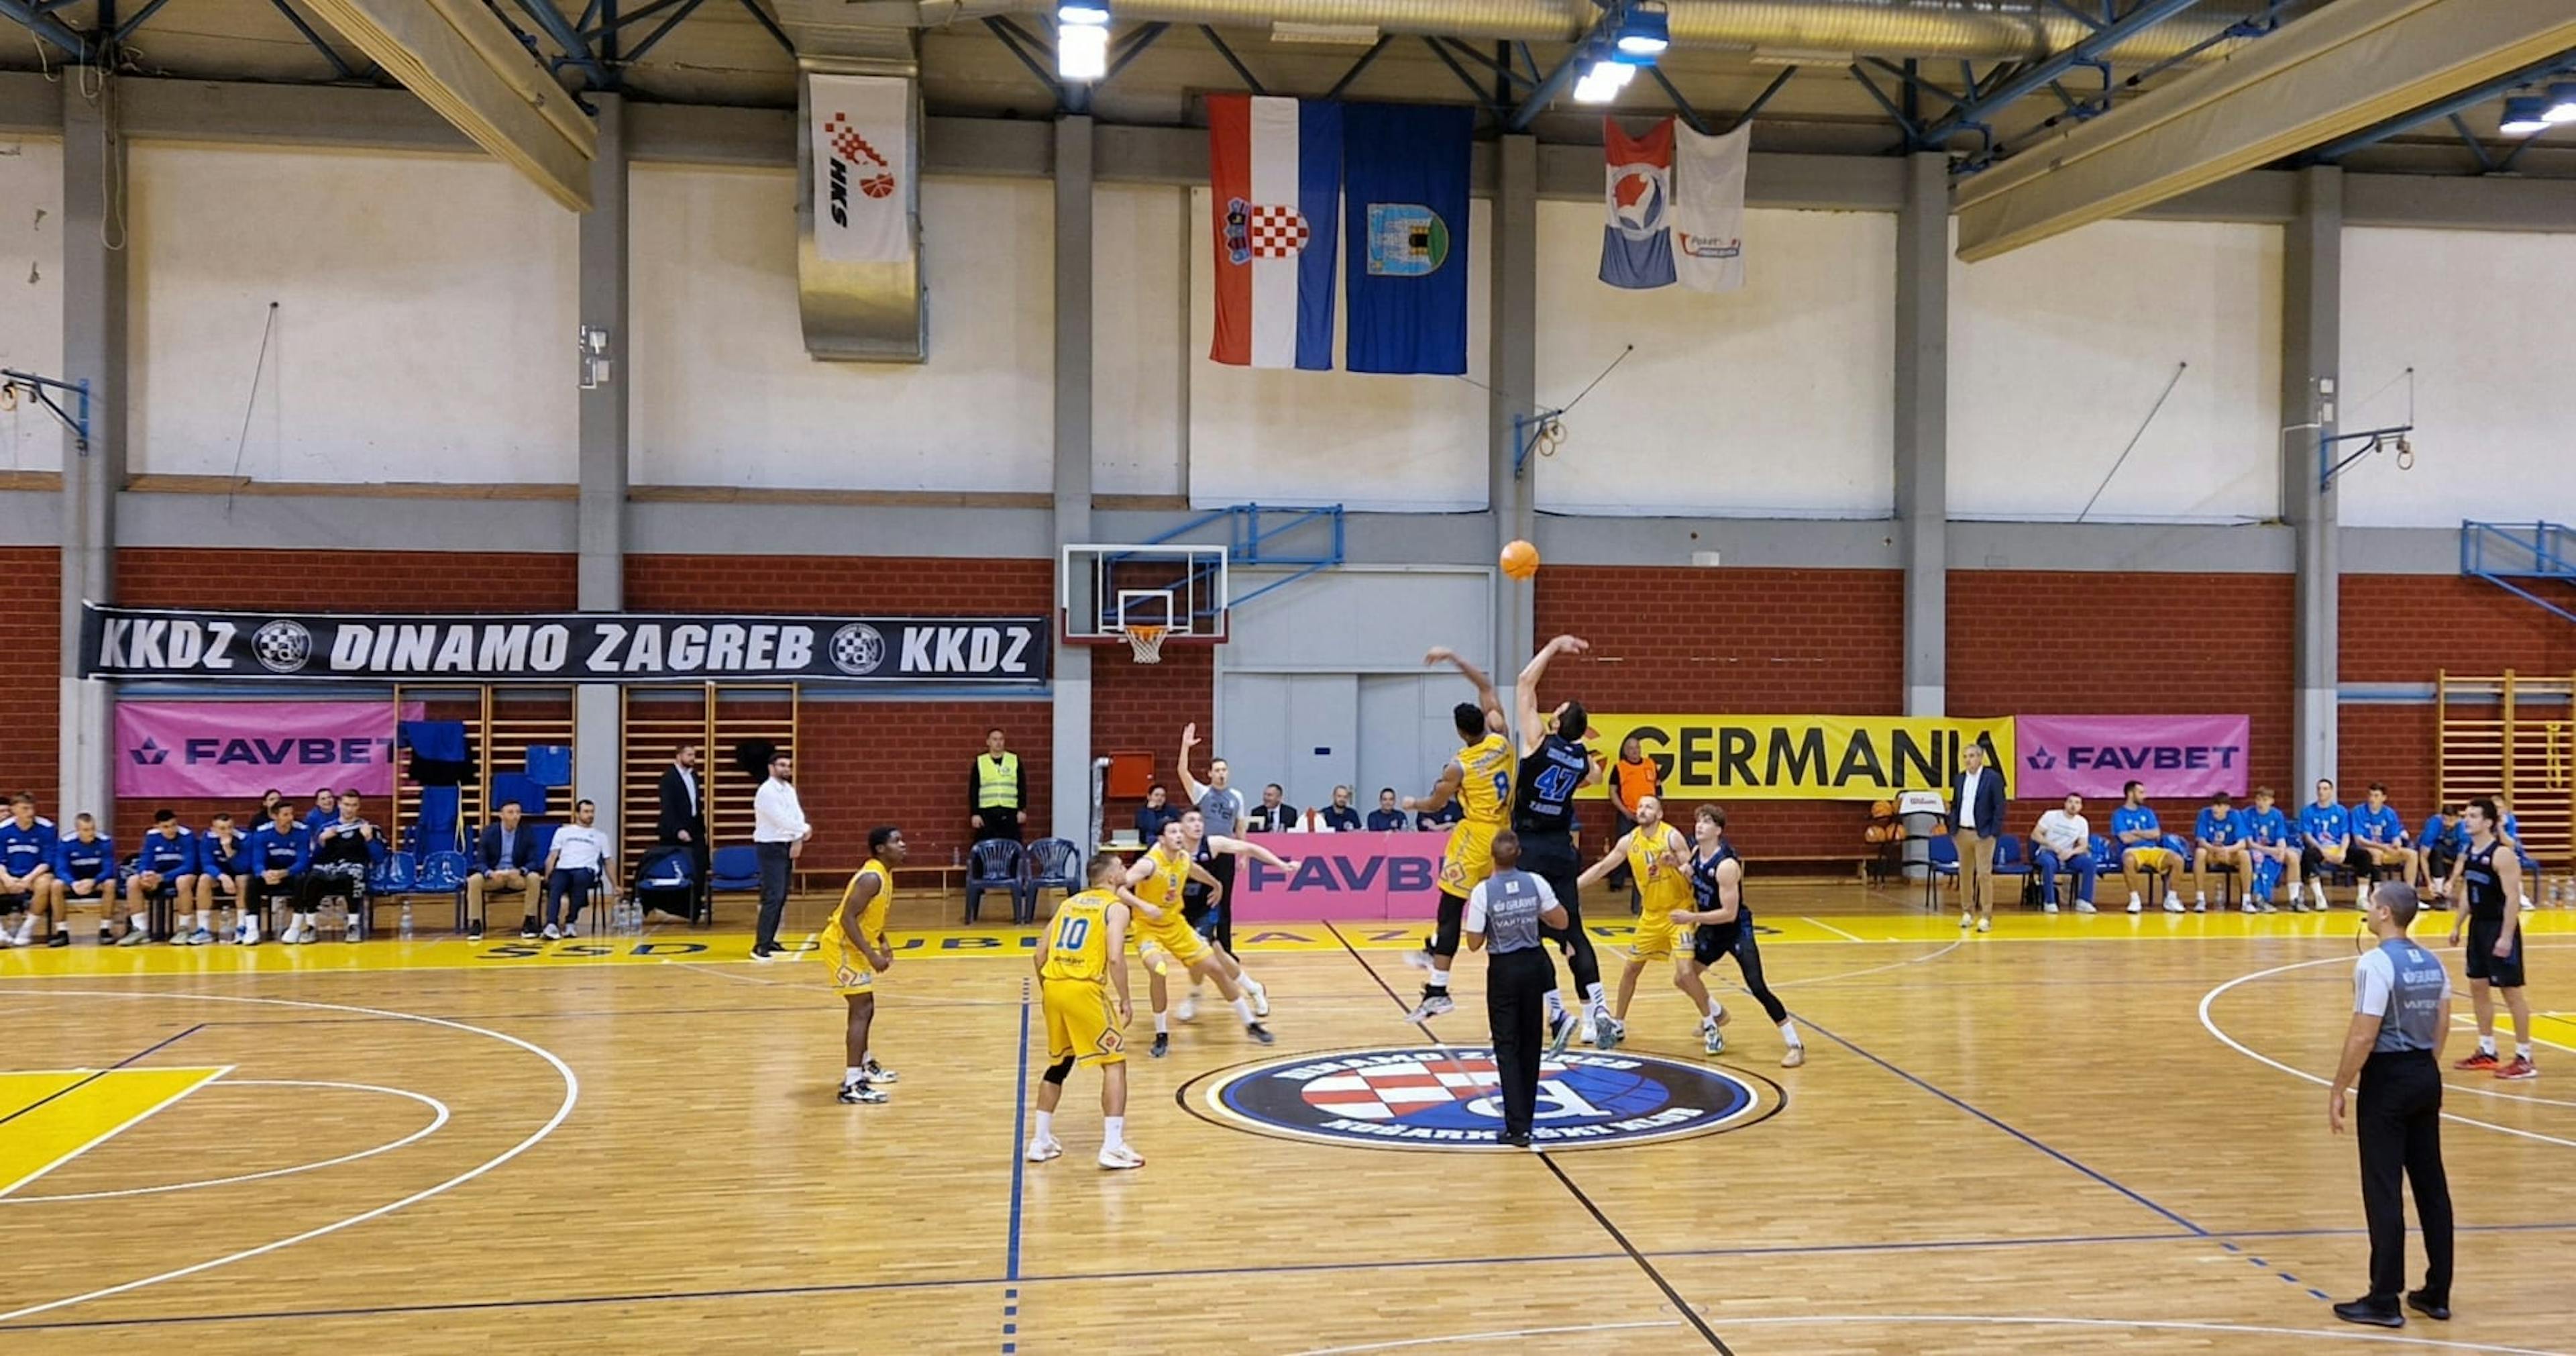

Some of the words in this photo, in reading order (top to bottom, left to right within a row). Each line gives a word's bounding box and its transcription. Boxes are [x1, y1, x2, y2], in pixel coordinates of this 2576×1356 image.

[829, 156, 848, 229] HKS
[100, 618, 235, 670] KKDZ
[330, 623, 570, 672] DINAMO
[586, 623, 814, 672] ZAGREB
[900, 627, 1032, 674] KKDZ
[2068, 745, 2239, 770] FAVBET
[1534, 764, 1580, 802] 47
[1249, 856, 1446, 892] FAVB
[1055, 915, 1089, 951] 10
